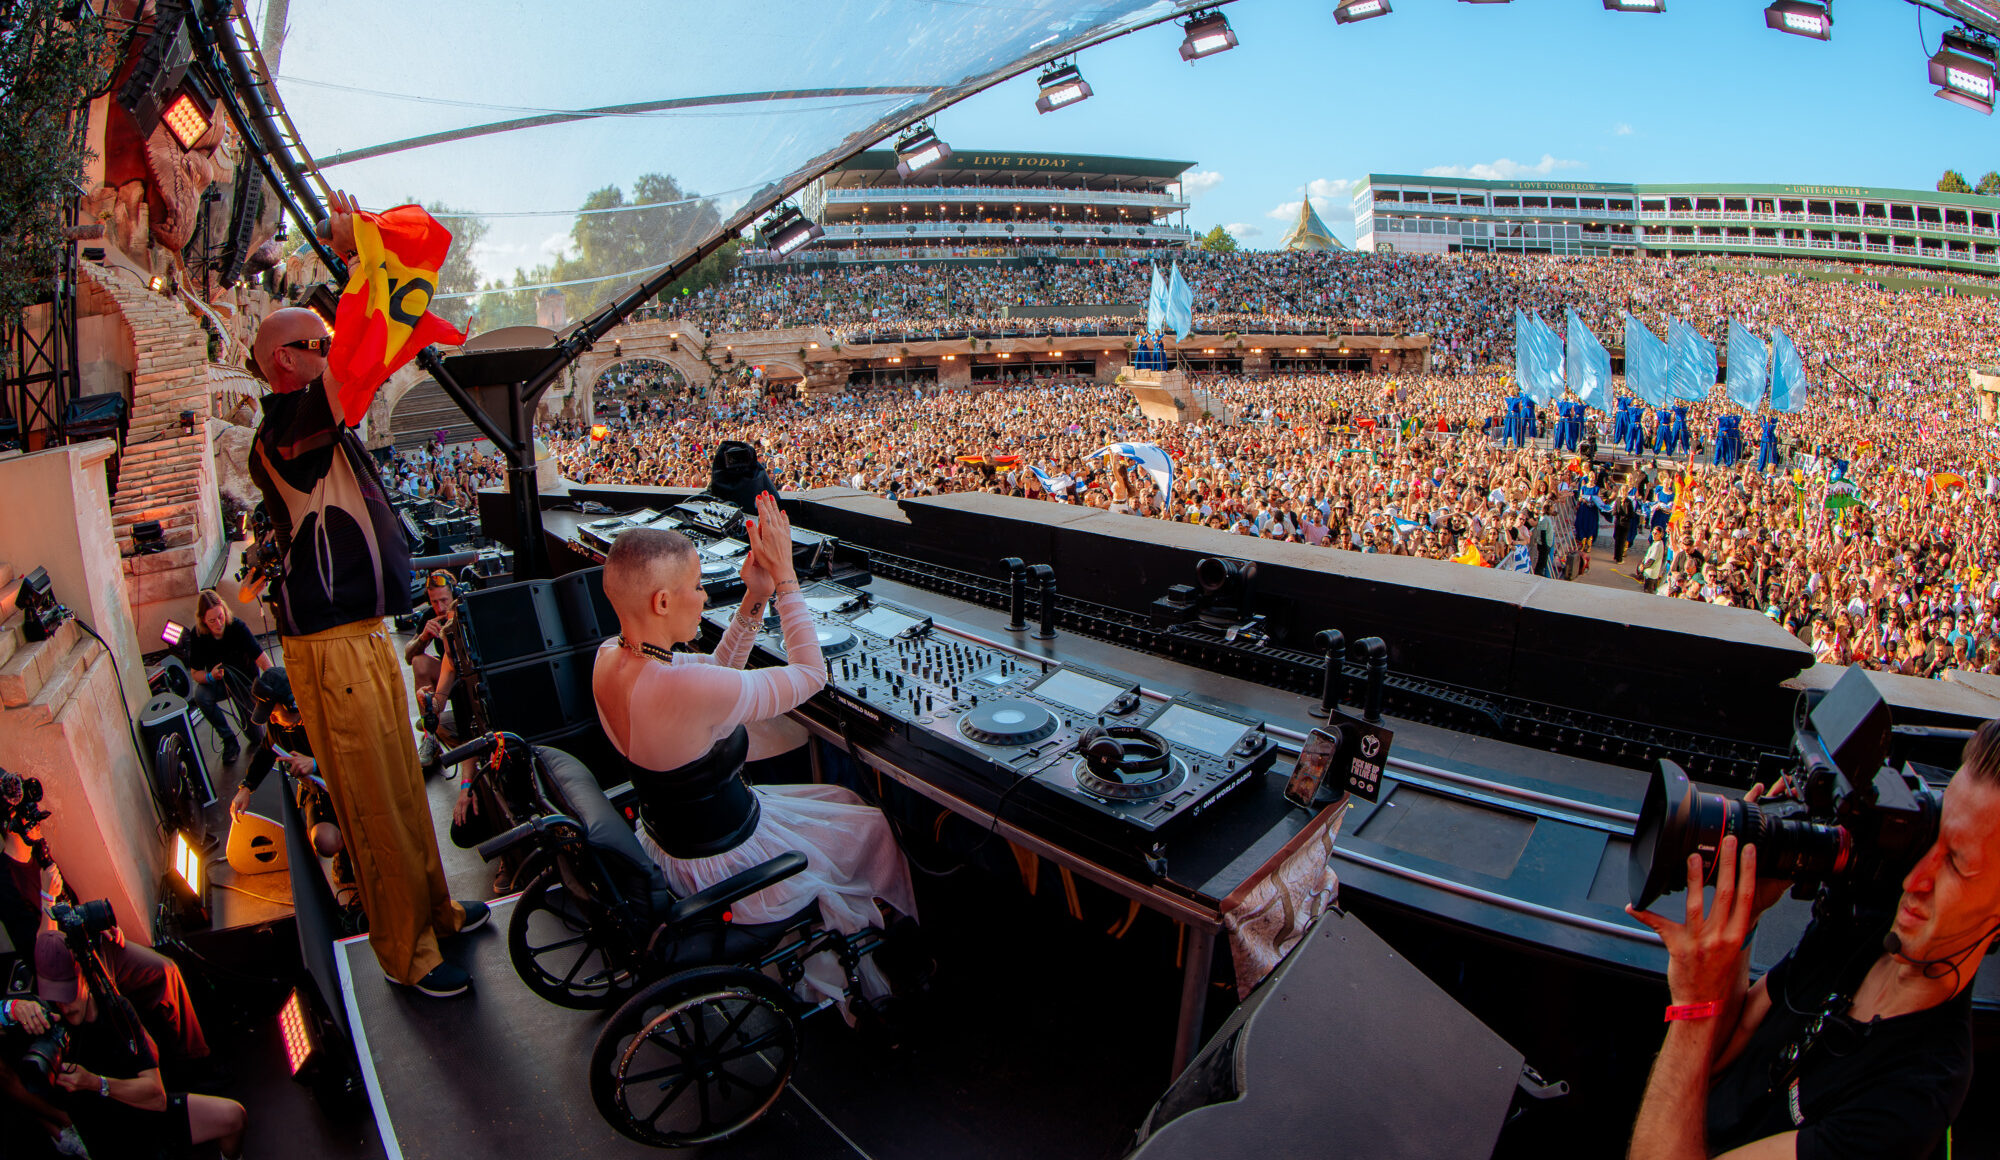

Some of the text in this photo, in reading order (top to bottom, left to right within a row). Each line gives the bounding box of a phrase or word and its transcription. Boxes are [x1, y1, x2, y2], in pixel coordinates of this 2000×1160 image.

[974, 156, 1070, 168] LIVE TODAY
[1519, 182, 1596, 191] LOVE TOMORROW
[1793, 186, 1861, 196] UNITE FOREVER
[1364, 762, 1373, 771] ME
[1372, 764, 1380, 774] UP
[1369, 772, 1378, 783] ON
[1203, 770, 1253, 809] ONE WORLD RADIO
